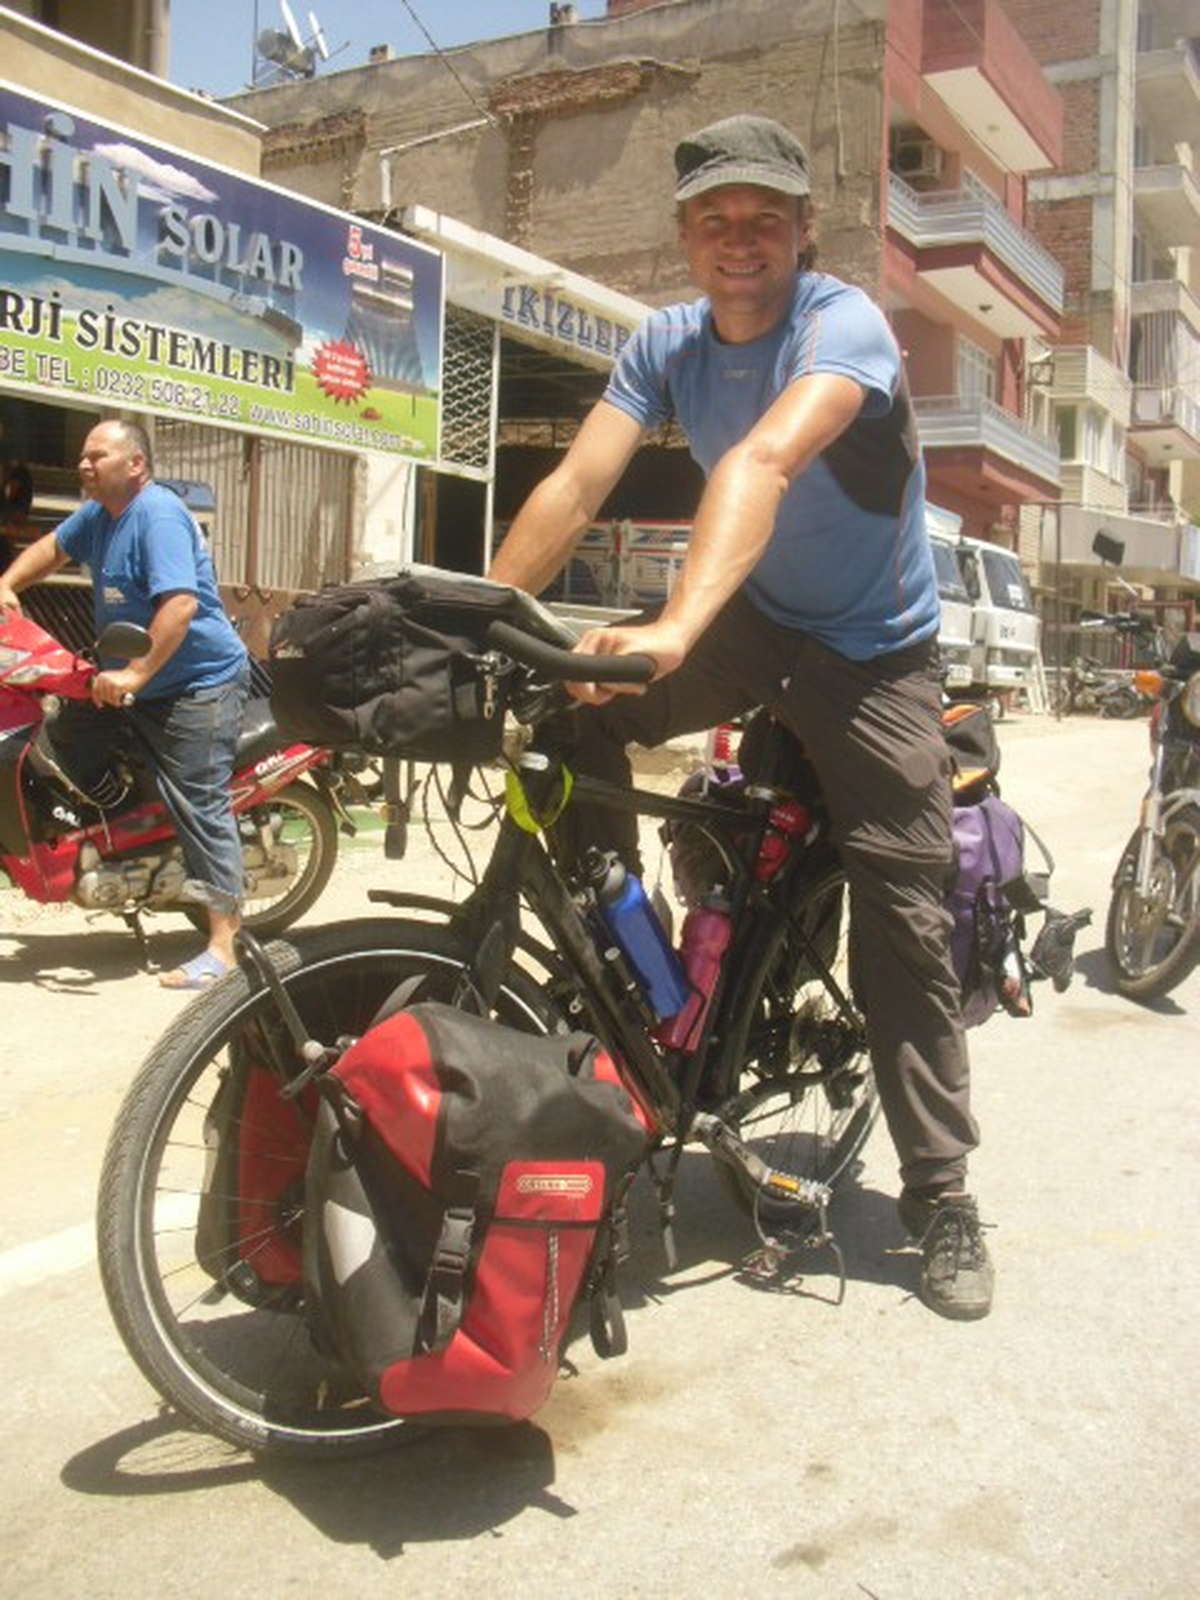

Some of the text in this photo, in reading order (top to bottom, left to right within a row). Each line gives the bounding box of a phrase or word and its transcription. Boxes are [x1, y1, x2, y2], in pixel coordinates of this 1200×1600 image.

[159, 203, 304, 292] SOLAR
[76, 304, 297, 392] SİSTEMLERİ
[96, 366, 144, 399] 0232
